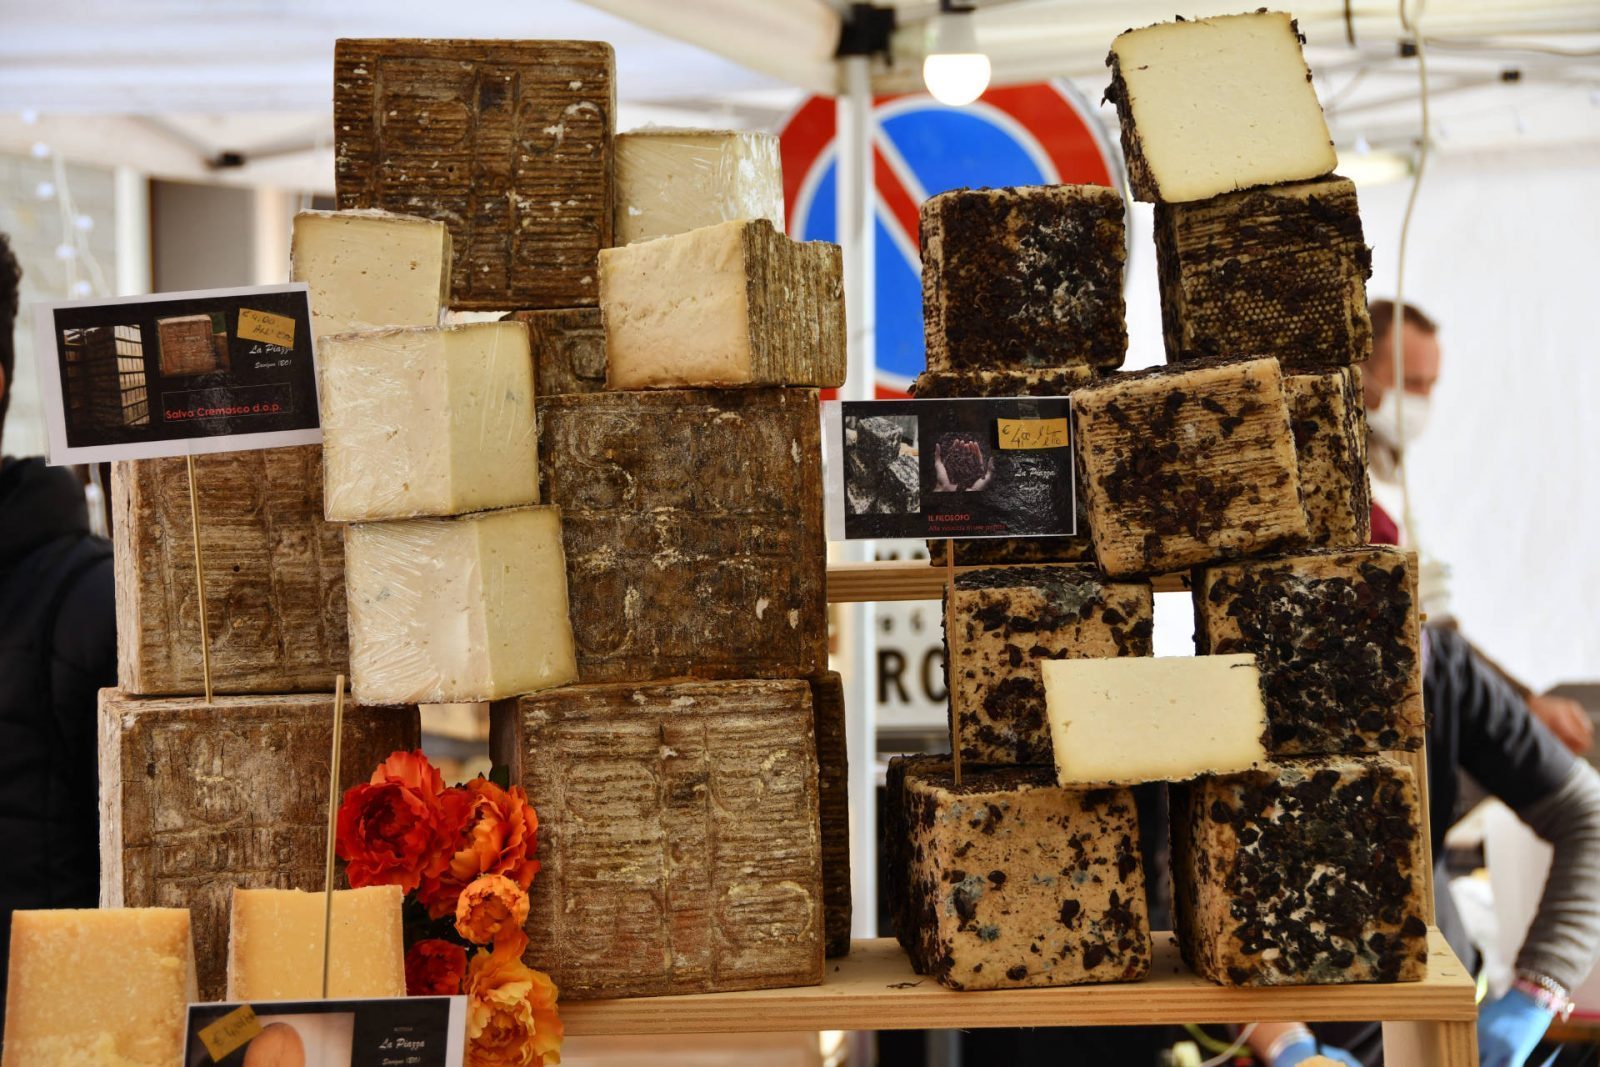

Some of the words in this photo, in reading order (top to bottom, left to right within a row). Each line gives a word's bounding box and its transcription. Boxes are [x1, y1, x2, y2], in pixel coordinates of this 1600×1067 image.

[248, 345, 262, 355] La
[265, 344, 291, 355] Piazz
[165, 409, 195, 420] Salva
[196, 406, 250, 417] Cremasco
[252, 403, 281, 413] d.o.p.
[378, 1038, 392, 1049] La
[395, 1037, 425, 1051] Piazza
